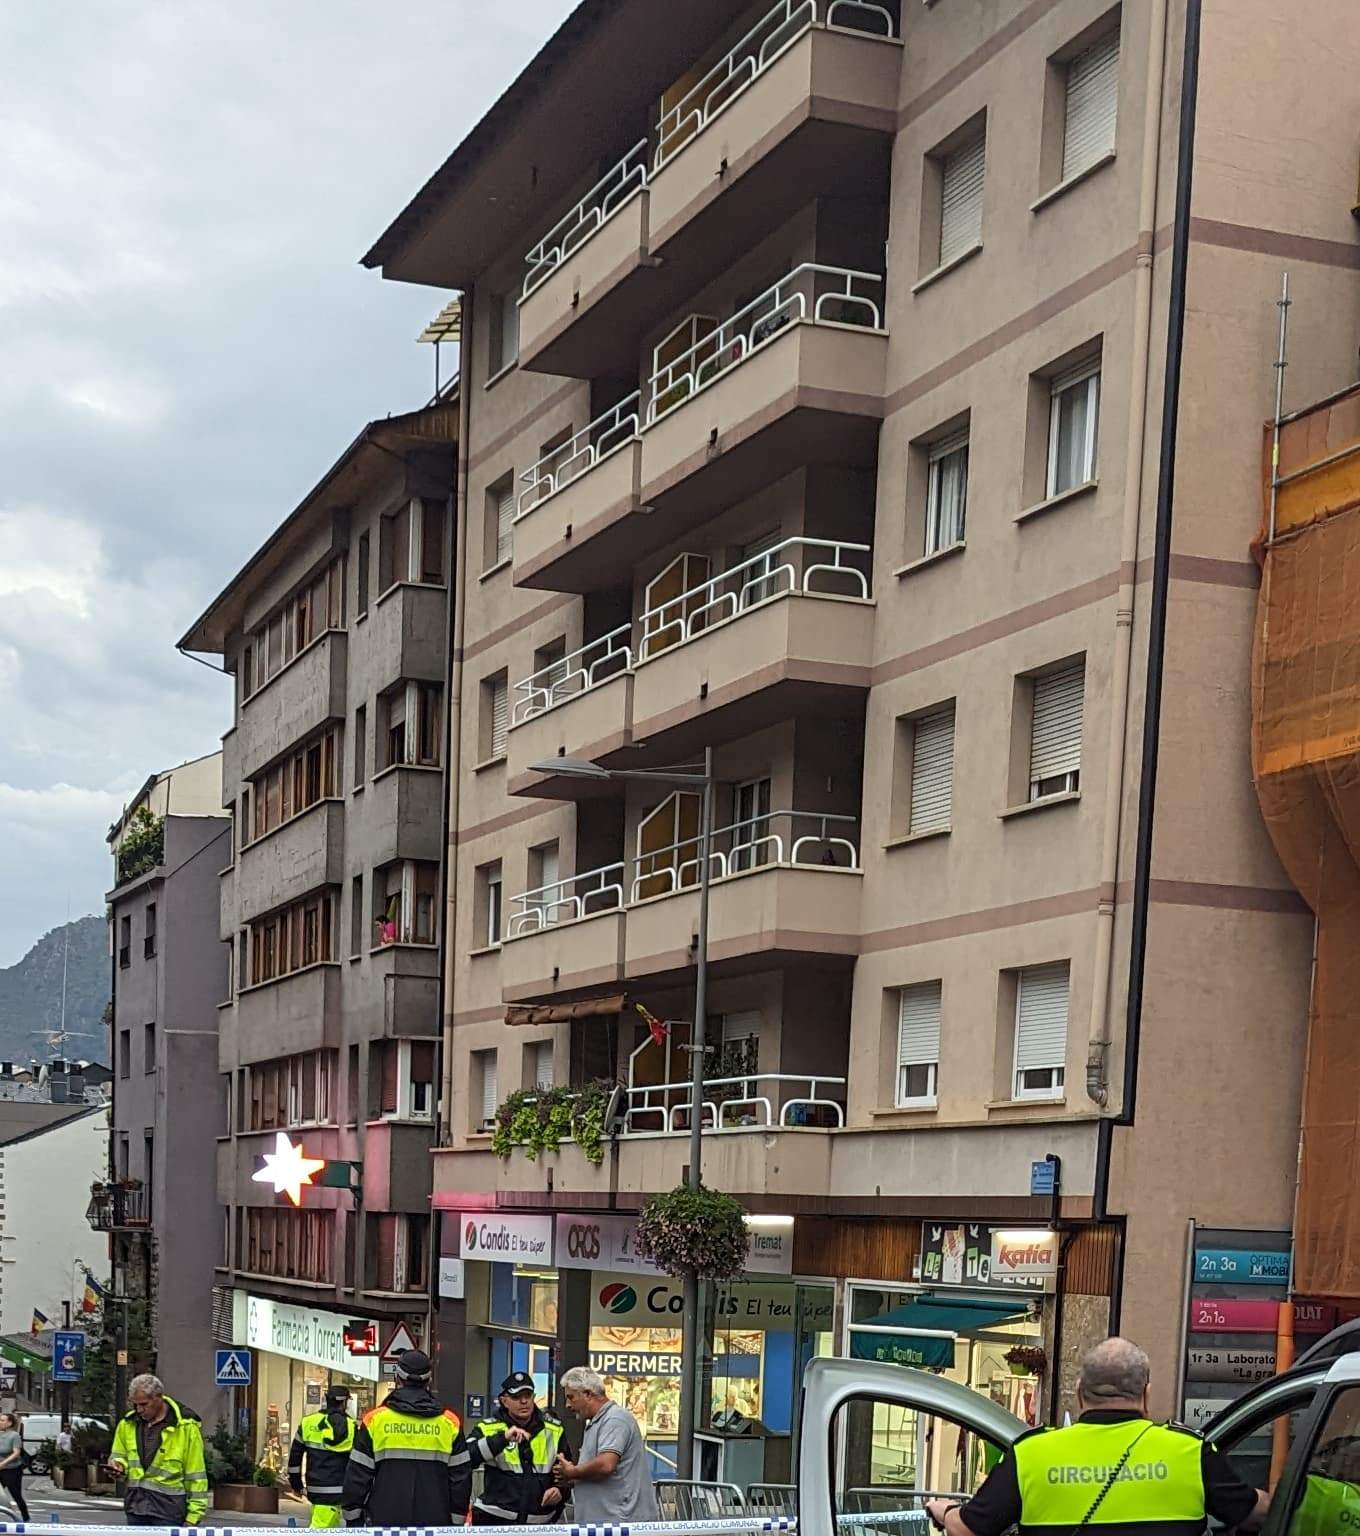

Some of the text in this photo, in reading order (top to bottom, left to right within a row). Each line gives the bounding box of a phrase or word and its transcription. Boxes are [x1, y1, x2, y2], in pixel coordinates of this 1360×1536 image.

[479, 1223, 509, 1251] Condis
[998, 1244, 1052, 1270] katia
[1201, 1256, 1217, 1271] 2n
[1221, 1256, 1237, 1272] 3a
[746, 1299, 761, 1315] El
[1199, 1310, 1212, 1325] 2n
[1214, 1310, 1225, 1324] 1a
[272, 1308, 309, 1352] Farmàcia
[1192, 1353, 1276, 1365] 1r 3a Laborato
[384, 1422, 441, 1436] CIRCULACIÓ
